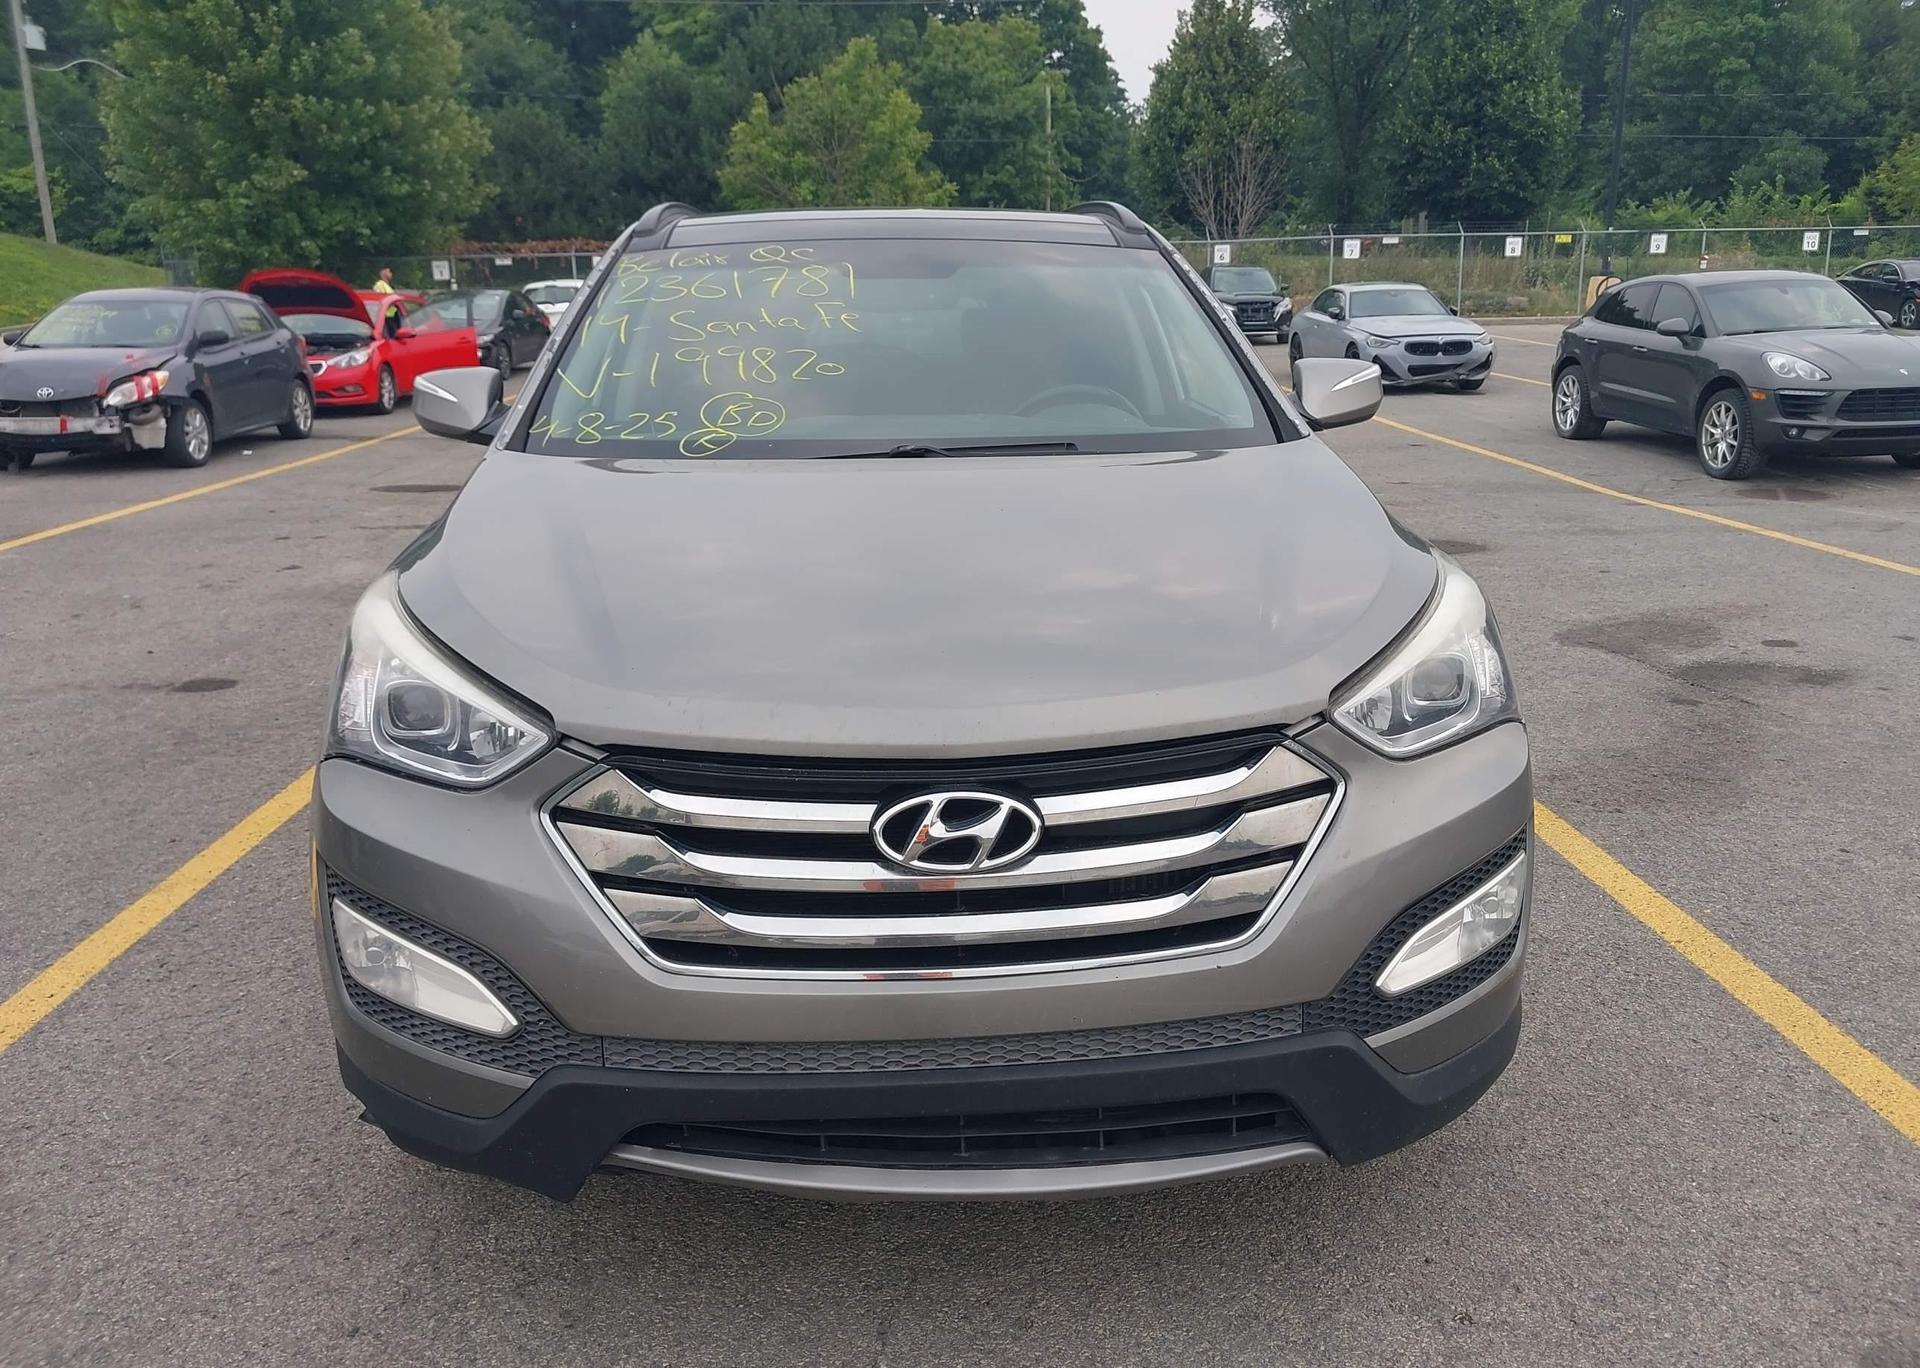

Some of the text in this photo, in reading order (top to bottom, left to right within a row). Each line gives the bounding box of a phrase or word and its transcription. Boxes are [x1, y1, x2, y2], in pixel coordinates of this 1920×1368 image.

[1806, 241, 1816, 249] 10
[668, 310, 807, 342] Santa
[814, 302, 863, 332] Fe
[556, 345, 846, 399] V-199820
